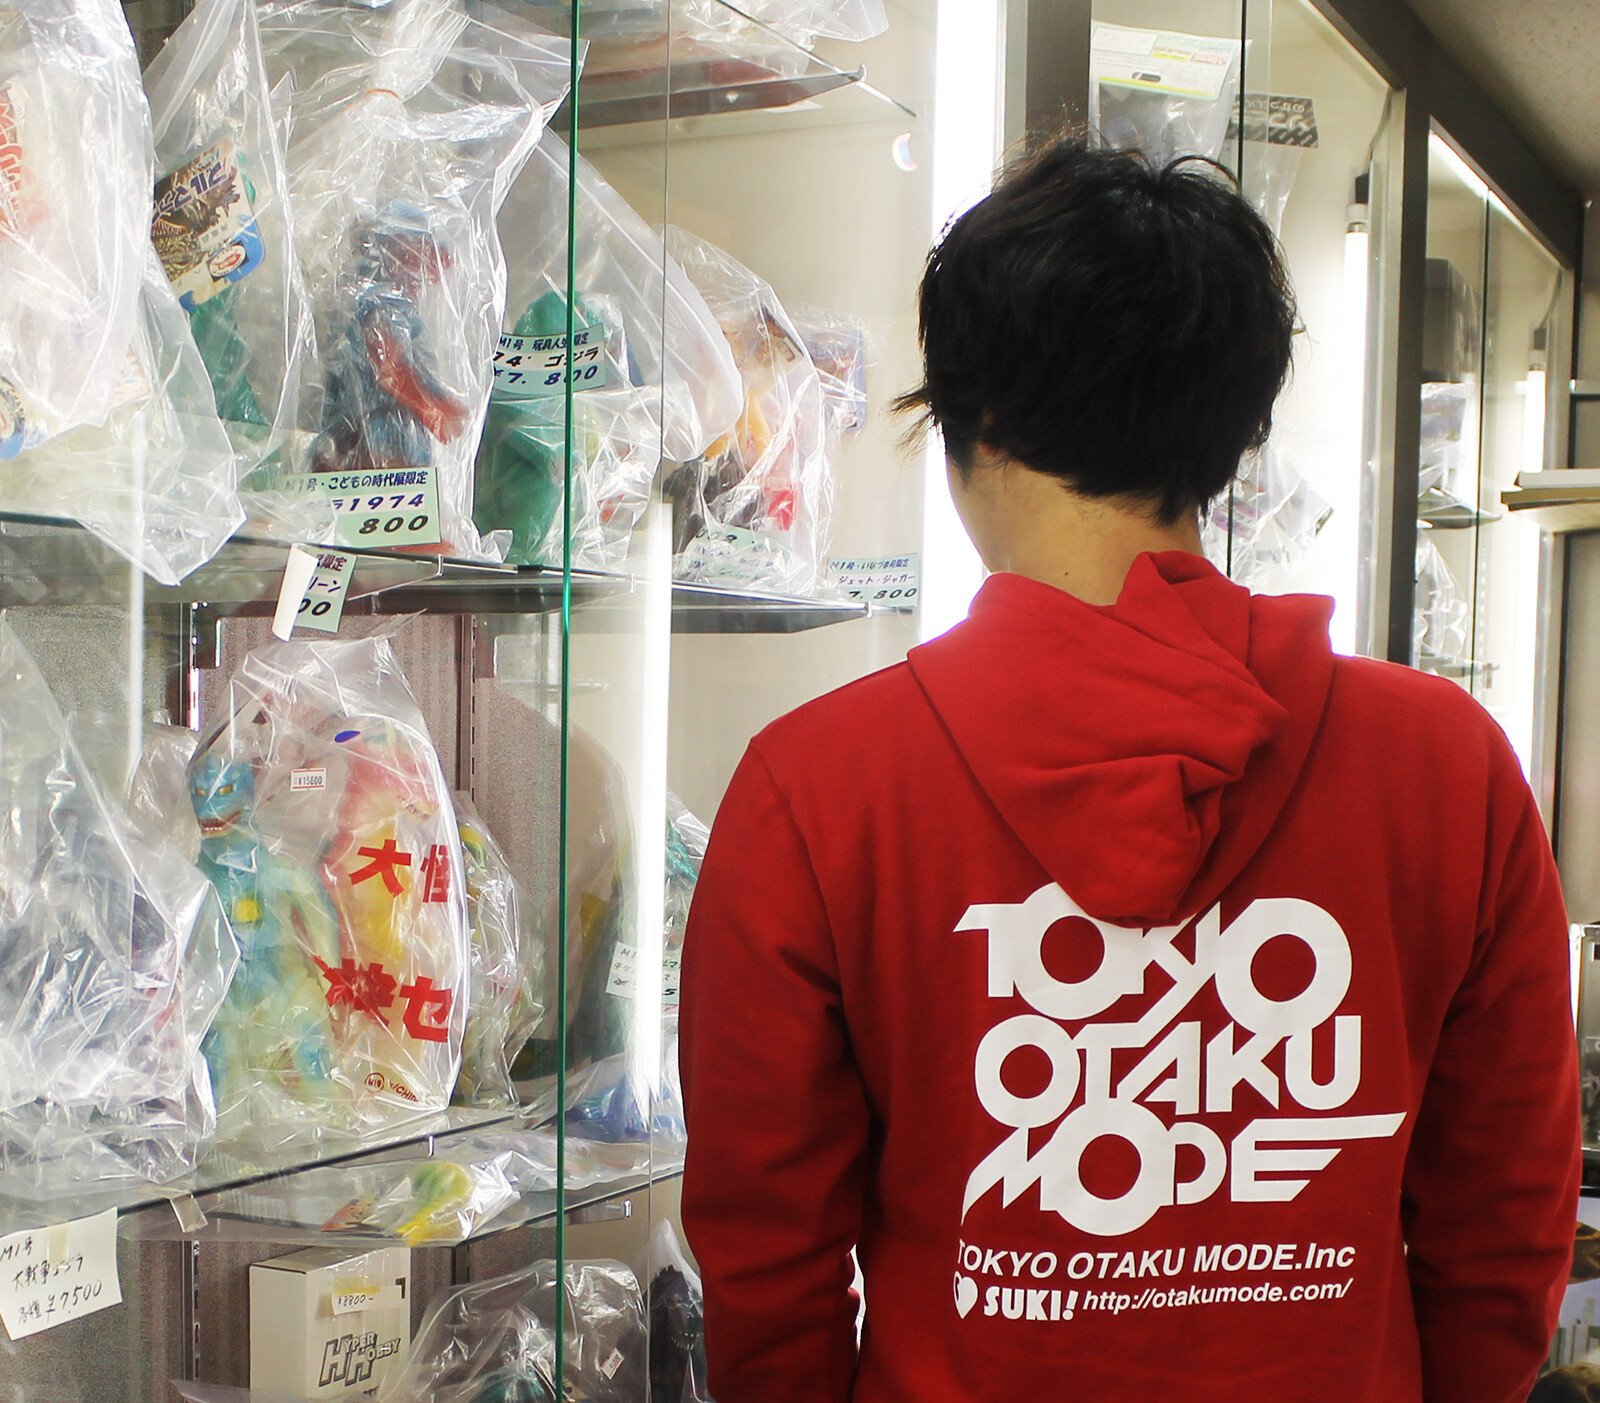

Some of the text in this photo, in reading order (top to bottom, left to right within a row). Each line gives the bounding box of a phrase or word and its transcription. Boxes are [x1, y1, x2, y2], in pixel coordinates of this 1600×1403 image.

[953, 881, 1353, 1035] TOKYO
[974, 1014, 1362, 1128] OTAKU
[960, 1100, 1407, 1236] MODE
[957, 1238, 1356, 1280] TOKYO OTAKU MODE.Inc
[983, 1277, 1354, 1322] SUKI! http://otakumode.com/
